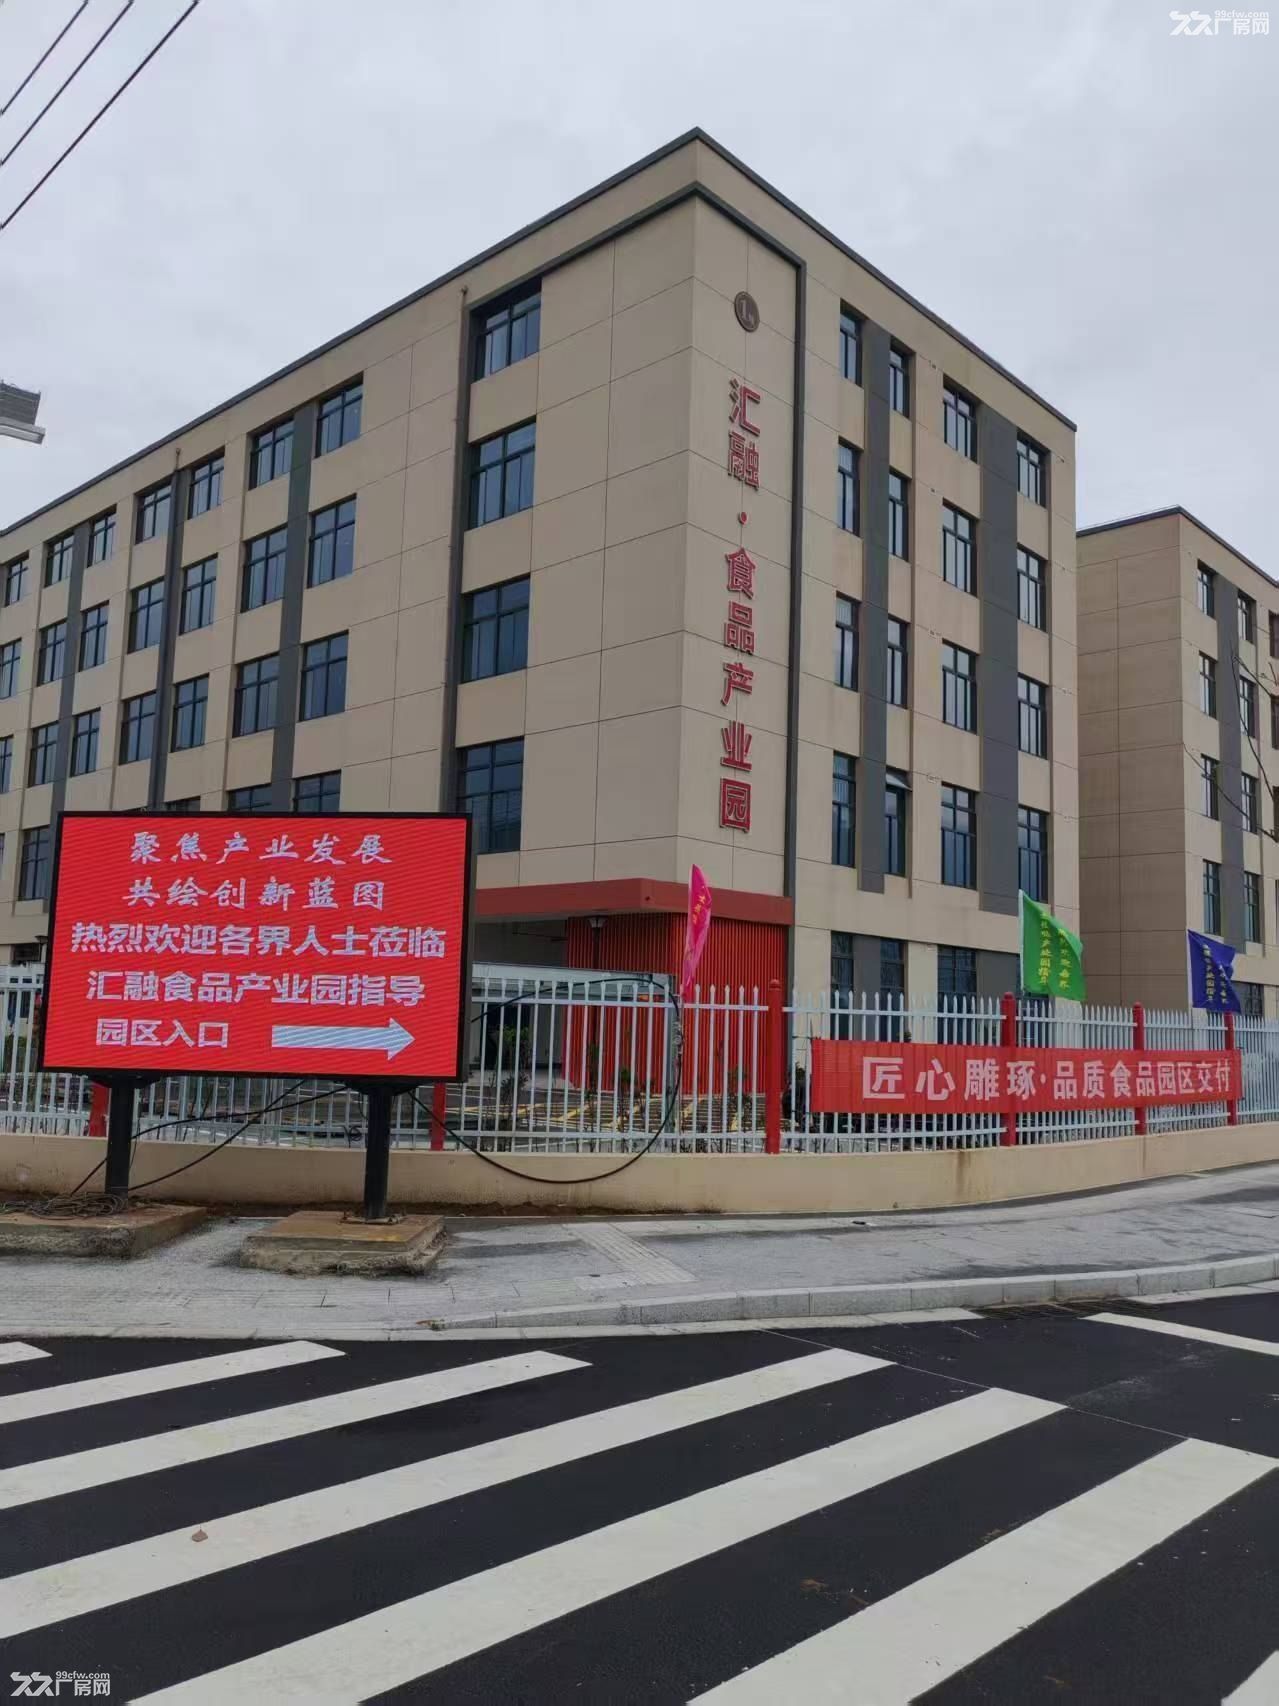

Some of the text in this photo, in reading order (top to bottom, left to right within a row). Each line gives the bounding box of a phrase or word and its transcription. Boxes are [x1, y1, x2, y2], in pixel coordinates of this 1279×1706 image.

[131, 832, 392, 864] 聚焦产业发展
[122, 876, 385, 911] 共绘创新蓝图
[70, 921, 447, 959] 热烈欢迎各界人士莅临
[86, 969, 425, 1007] 汇融食品产业园指导
[96, 1018, 229, 1049] 园区入口
[863, 1056, 1231, 1101] 匠心雕琢·品质食品园区交付
